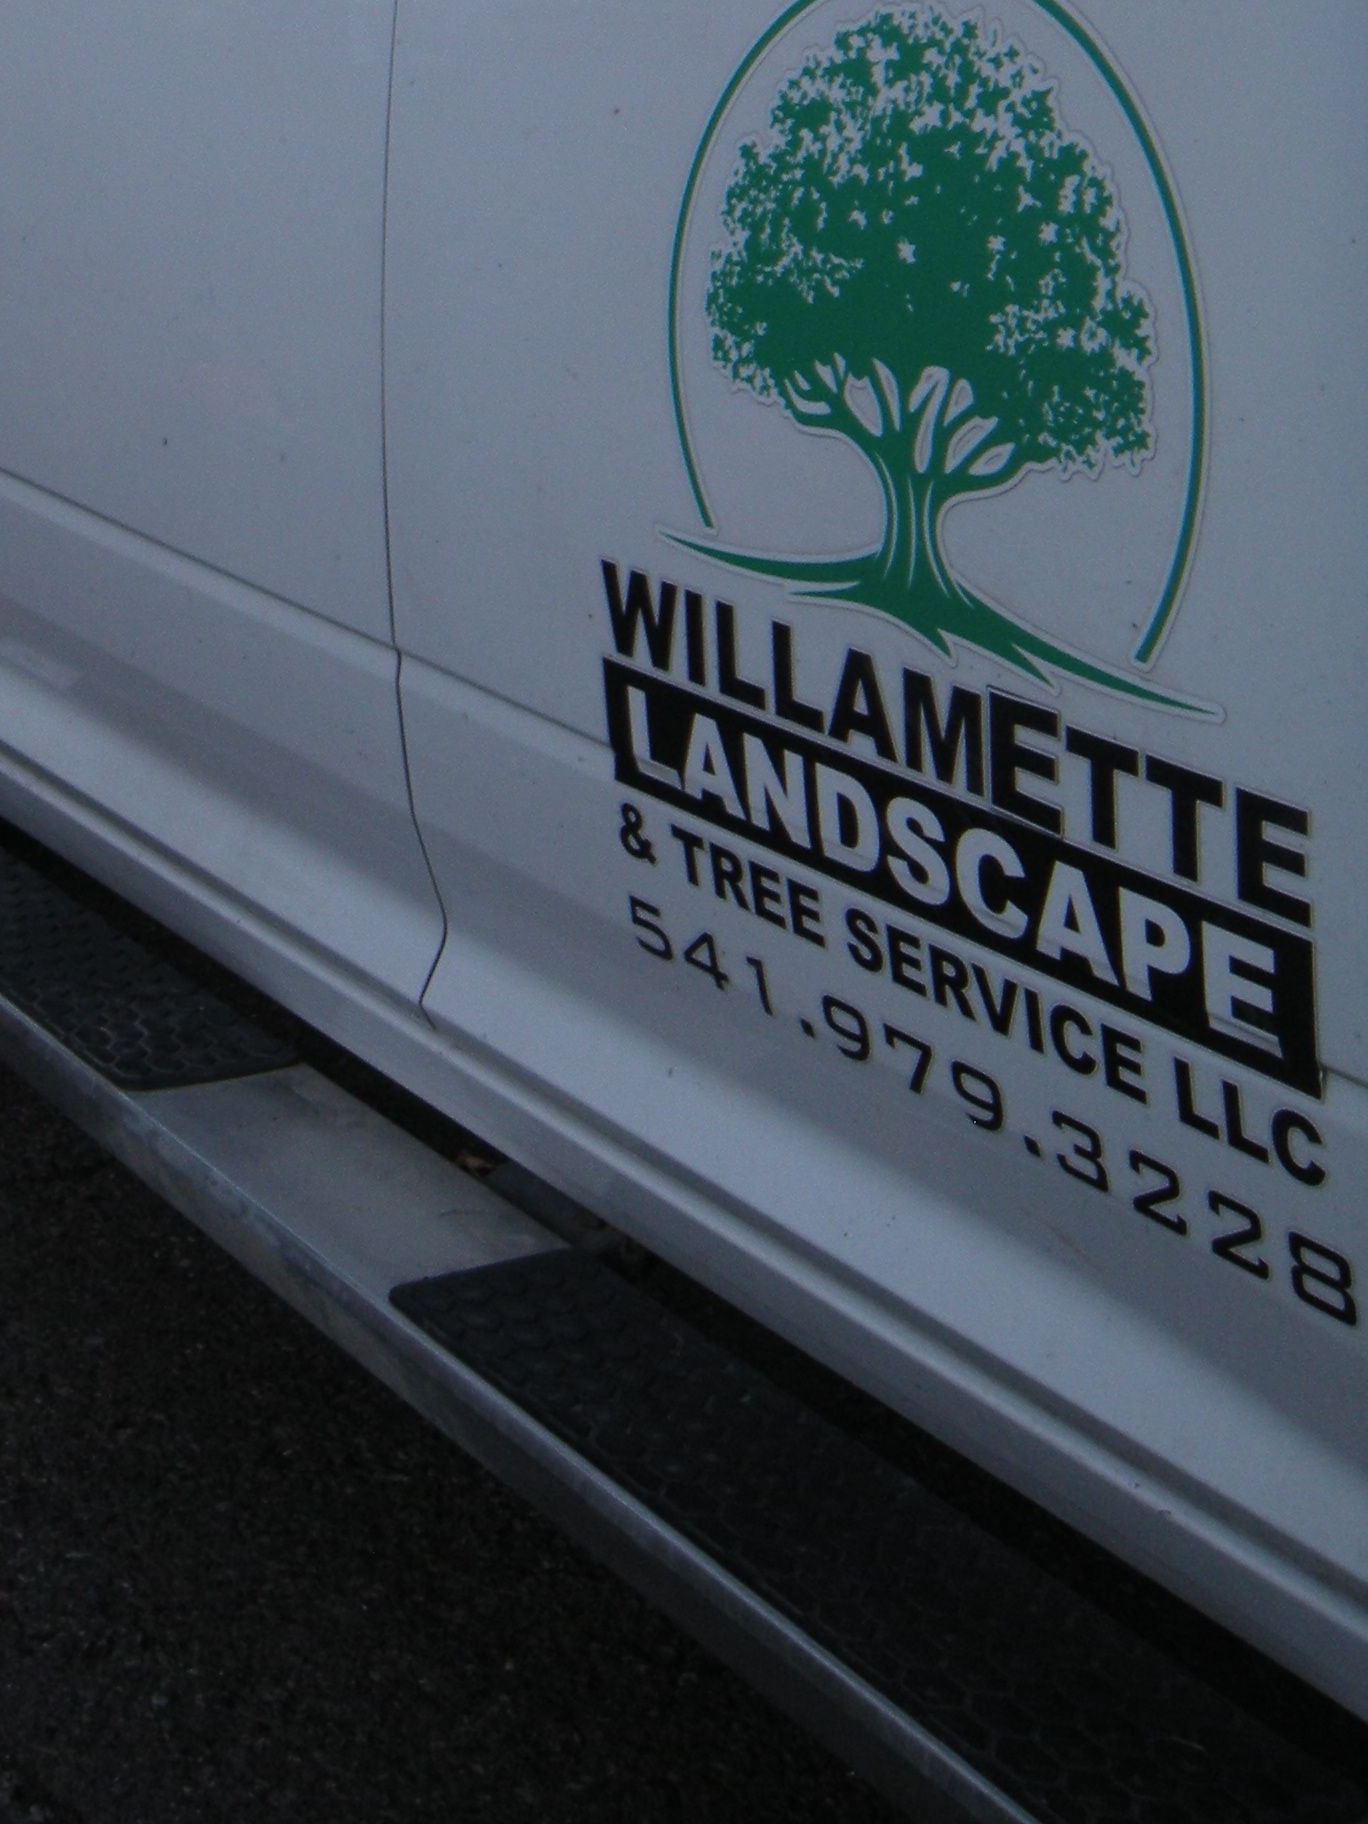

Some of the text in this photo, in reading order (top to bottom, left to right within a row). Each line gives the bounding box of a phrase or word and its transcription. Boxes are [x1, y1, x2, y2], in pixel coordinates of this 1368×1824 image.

[600, 559, 1313, 927] WILLAMETTE
[624, 680, 1285, 1059] LANDSCAPE
[618, 801, 1328, 1188] & TREE SERVICE LLC
[628, 895, 1358, 1327] 541.979.3228
